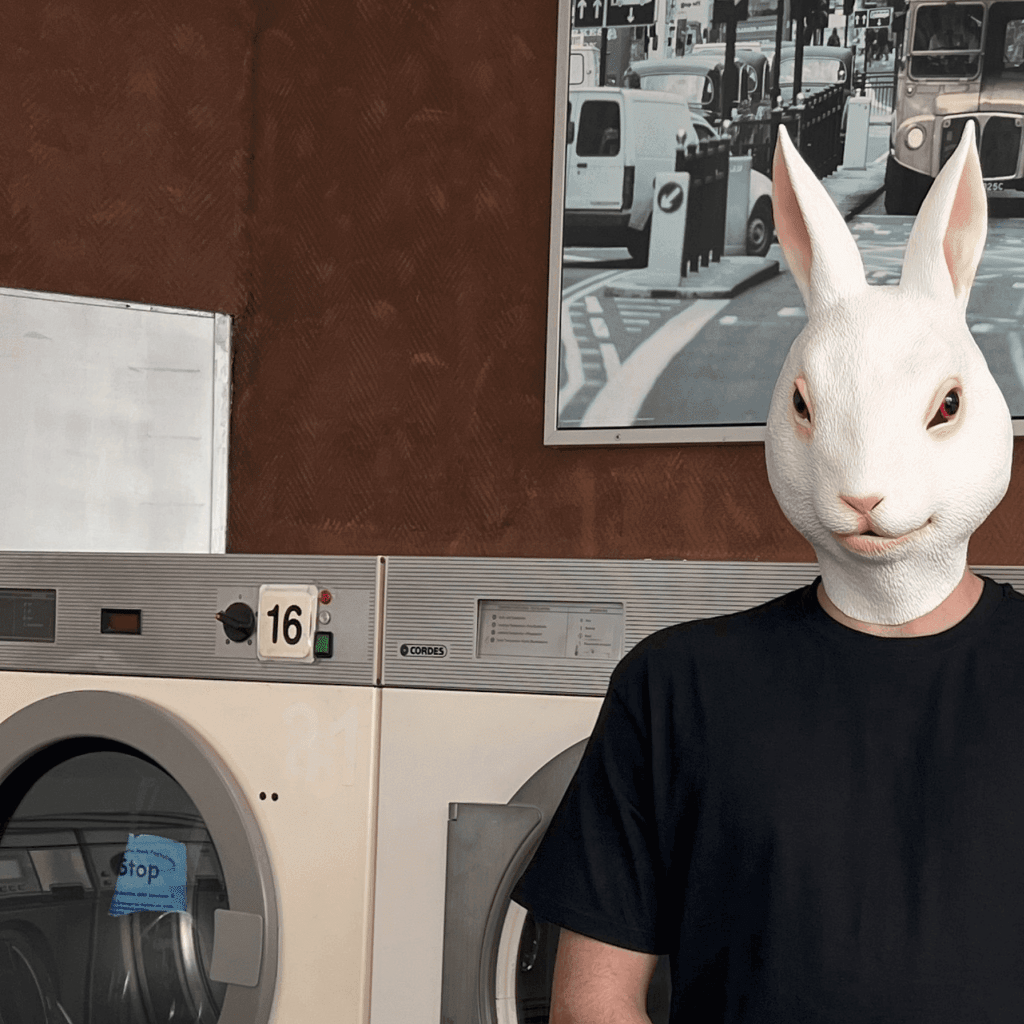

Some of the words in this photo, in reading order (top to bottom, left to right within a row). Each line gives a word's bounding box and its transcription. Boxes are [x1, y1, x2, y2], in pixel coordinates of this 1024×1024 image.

[267, 604, 303, 646] 16
[410, 646, 445, 656] CORDES
[119, 858, 160, 885] Stop
